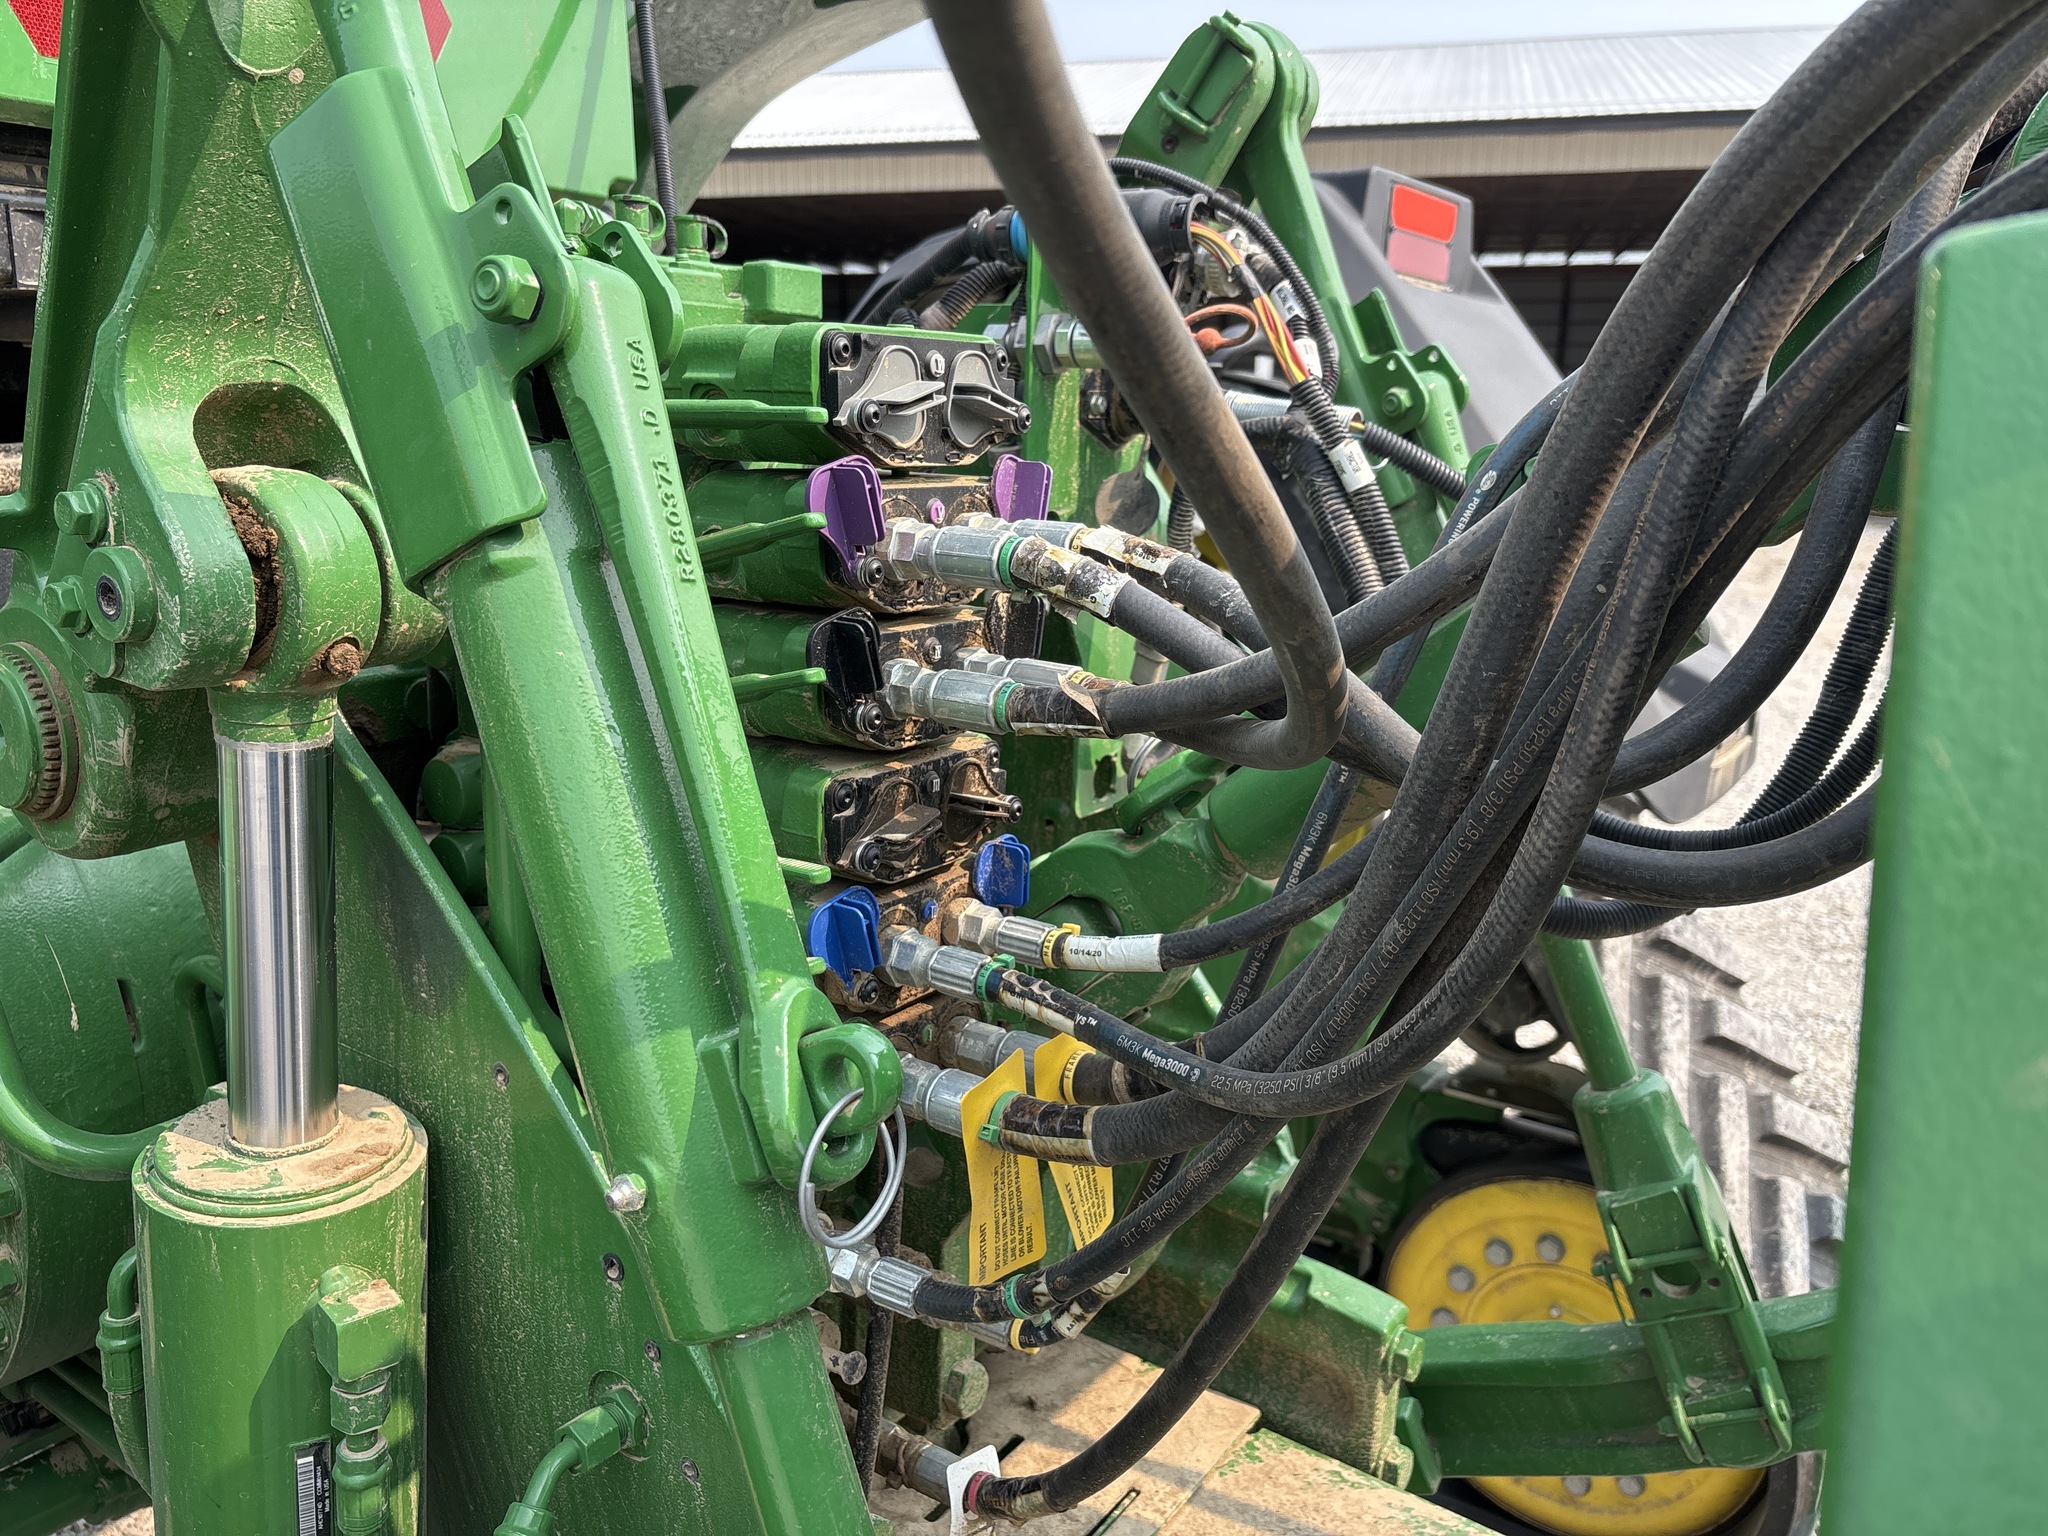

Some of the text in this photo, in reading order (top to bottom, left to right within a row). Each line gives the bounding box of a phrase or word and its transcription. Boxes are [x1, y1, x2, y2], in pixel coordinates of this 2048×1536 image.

[621, 330, 651, 394] USA
[649, 455, 696, 586] R280371
[1134, 547, 1157, 564] Gates
[1546, 684, 1575, 718] MPa
[1279, 809, 1329, 897] 6M3K Mega30
[1419, 879, 1443, 904] ISO
[1394, 900, 1427, 944] 11237
[1041, 932, 1056, 957] MARK
[1068, 947, 1101, 957] 10/14/20
[1375, 940, 1400, 968] R17
[1241, 959, 1261, 985] MPa
[1353, 971, 1377, 998] SAE
[1325, 992, 1361, 1039] 100R17
[1064, 1051, 1081, 1079] FRAME
[1115, 1034, 1190, 1076] 6M3K Mega3000
[1210, 1075, 1233, 1090] 22.5
[1232, 1080, 1251, 1093] MPa
[1370, 1032, 1391, 1055] ISO
[1304, 1040, 1326, 1063] ISO
[1215, 1132, 1245, 1162] Flame
[1007, 1178, 1012, 1189] TO
[1073, 1170, 1085, 1207] CONNECT
[1083, 1166, 1093, 1200] CONNEC
[1144, 1169, 1164, 1193] R17
[1176, 1156, 1219, 1199] Resistant
[1064, 1182, 1086, 1246] MPORTANT
[1152, 1194, 1180, 1222] MSHA
[994, 1259, 1000, 1270] DO
[1018, 1245, 1025, 1256] OR
[1018, 1333, 1035, 1342] Fla
